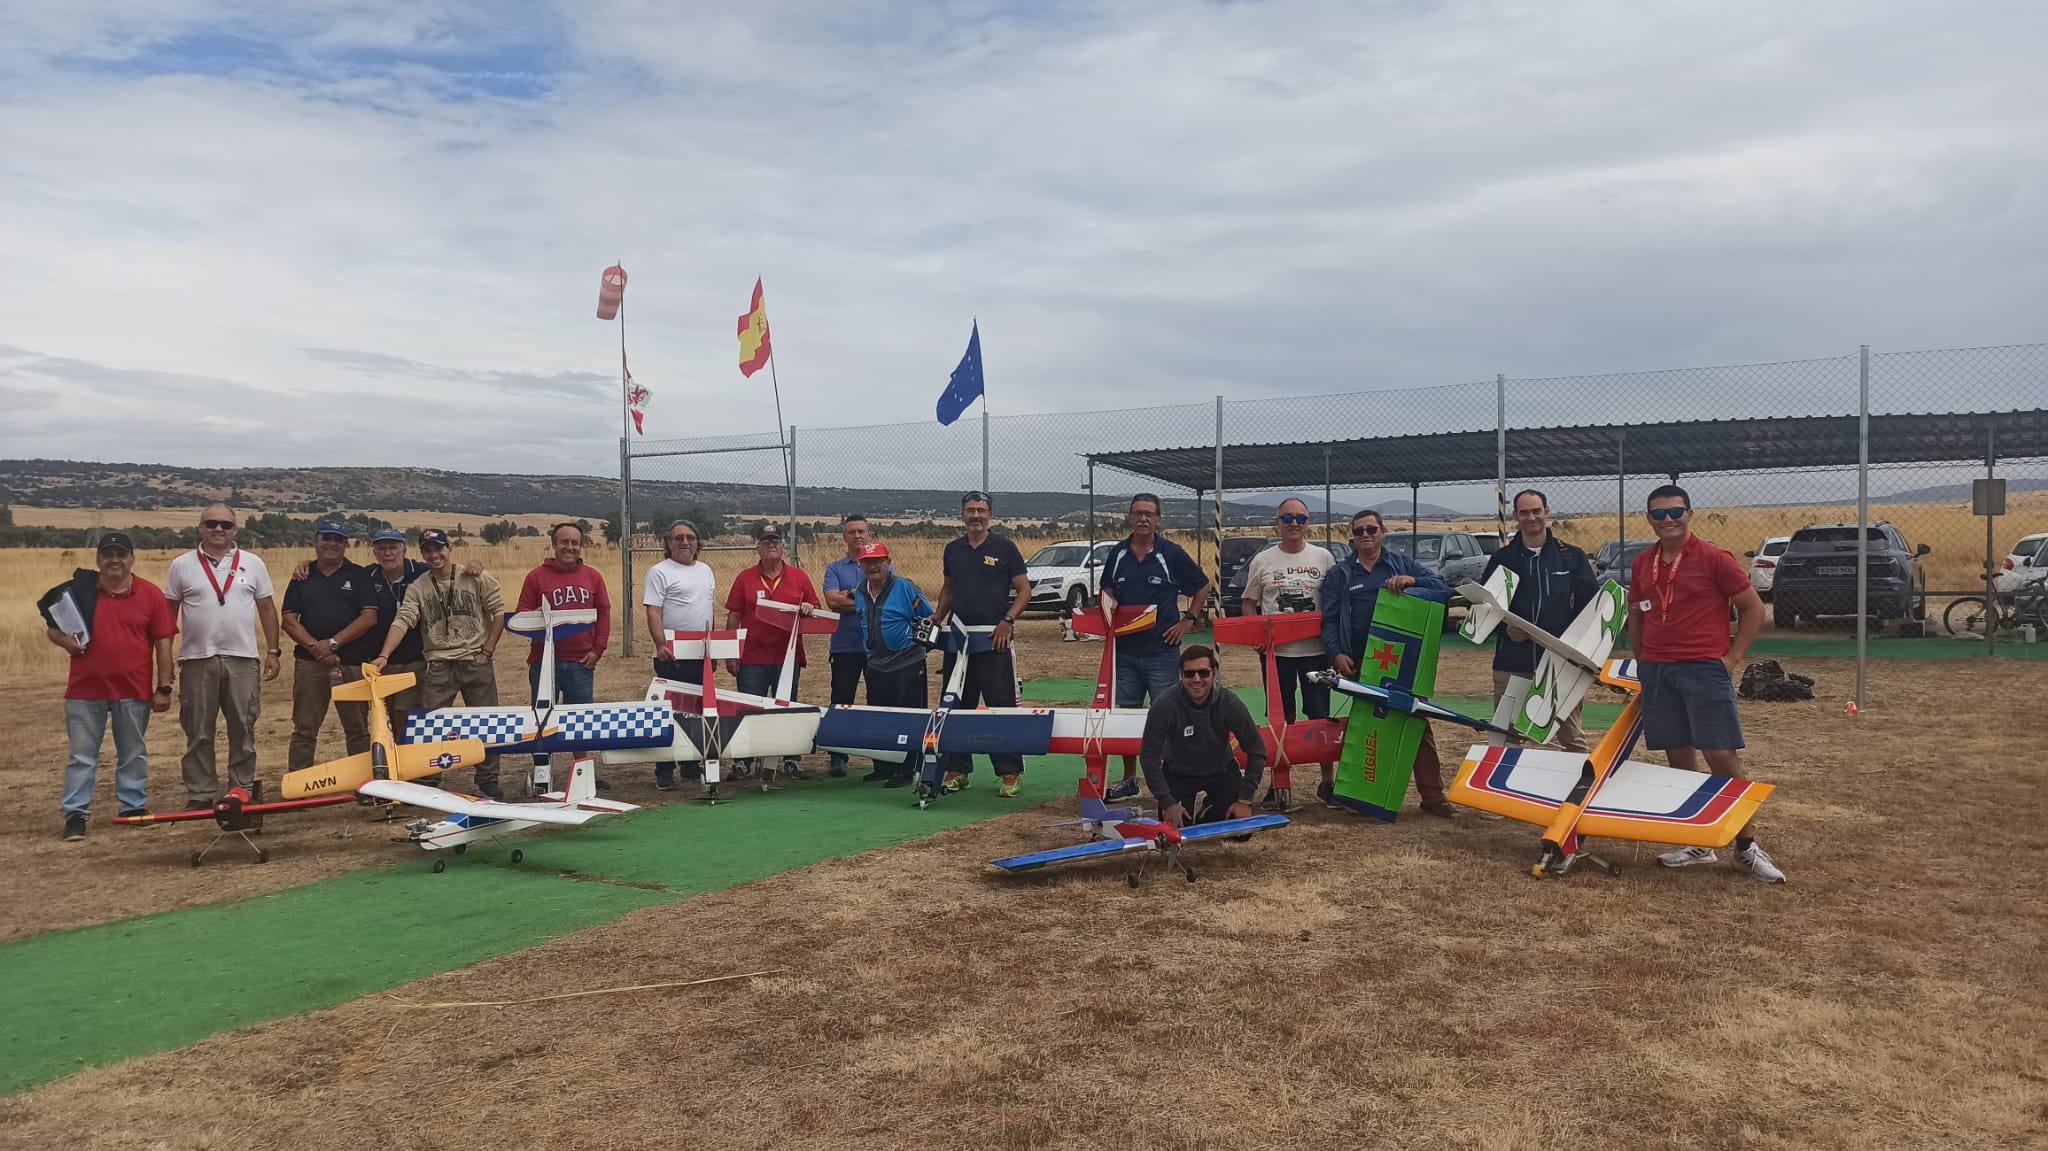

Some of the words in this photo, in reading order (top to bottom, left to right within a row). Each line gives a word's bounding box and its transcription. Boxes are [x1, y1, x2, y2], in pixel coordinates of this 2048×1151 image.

[552, 585, 590, 606] GAP
[1363, 729, 1378, 783] MIGUEL
[304, 776, 336, 792] NAVY
